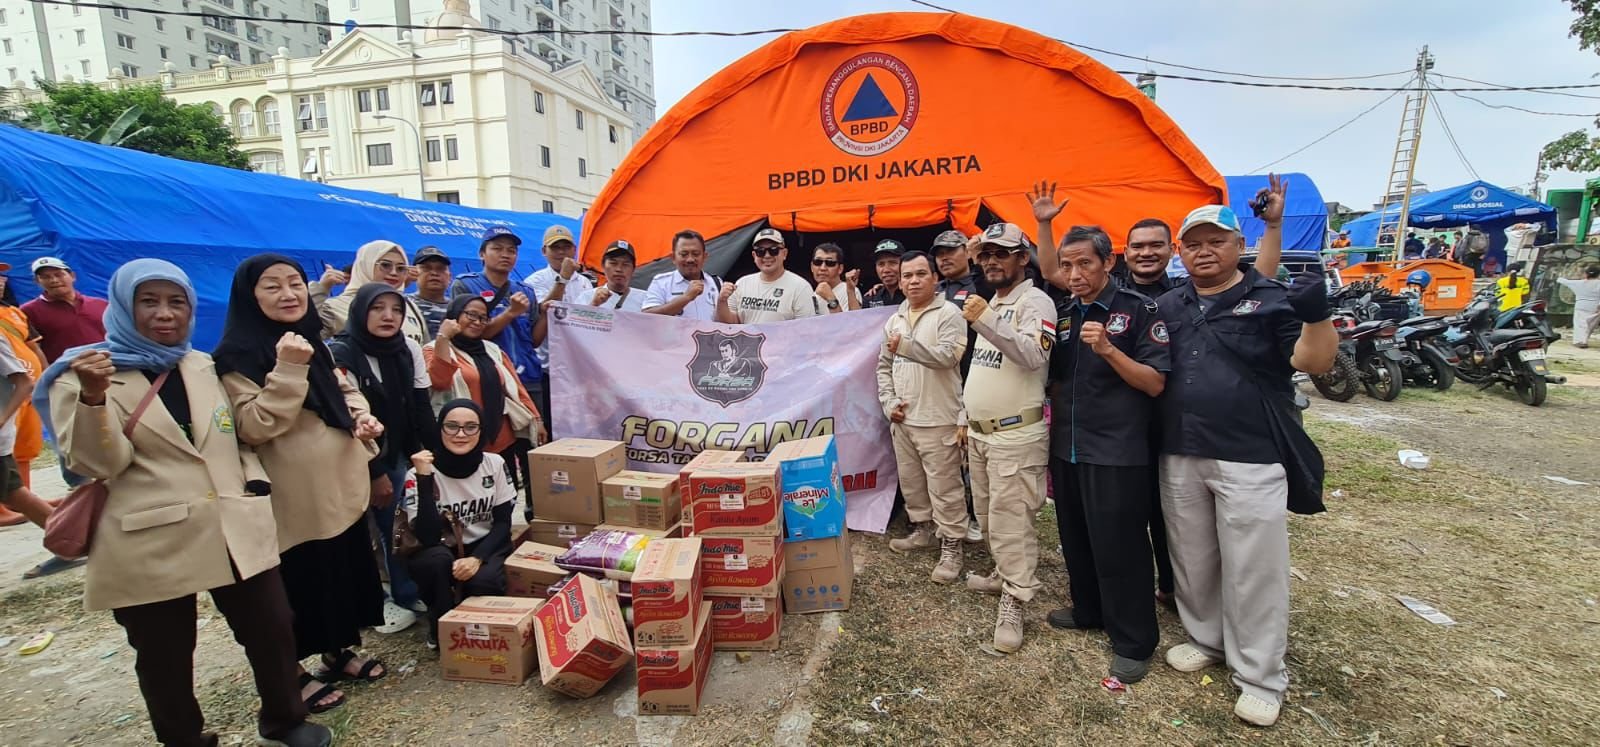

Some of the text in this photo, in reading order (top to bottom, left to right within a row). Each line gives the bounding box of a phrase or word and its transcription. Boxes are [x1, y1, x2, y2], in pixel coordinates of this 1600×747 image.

[825, 57, 915, 131] BADAN PENANGGULANGAN BENCANA DAERAH
[850, 121, 889, 136] BPBD
[877, 129, 905, 150] JAKARTA
[768, 154, 981, 190] BPBD DKI JAKARTA
[741, 296, 780, 309] FORGANA
[697, 375, 755, 387] FORSA
[621, 415, 834, 452] FORGANA
[784, 487, 829, 501] Minerale
[802, 498, 816, 509] Le
